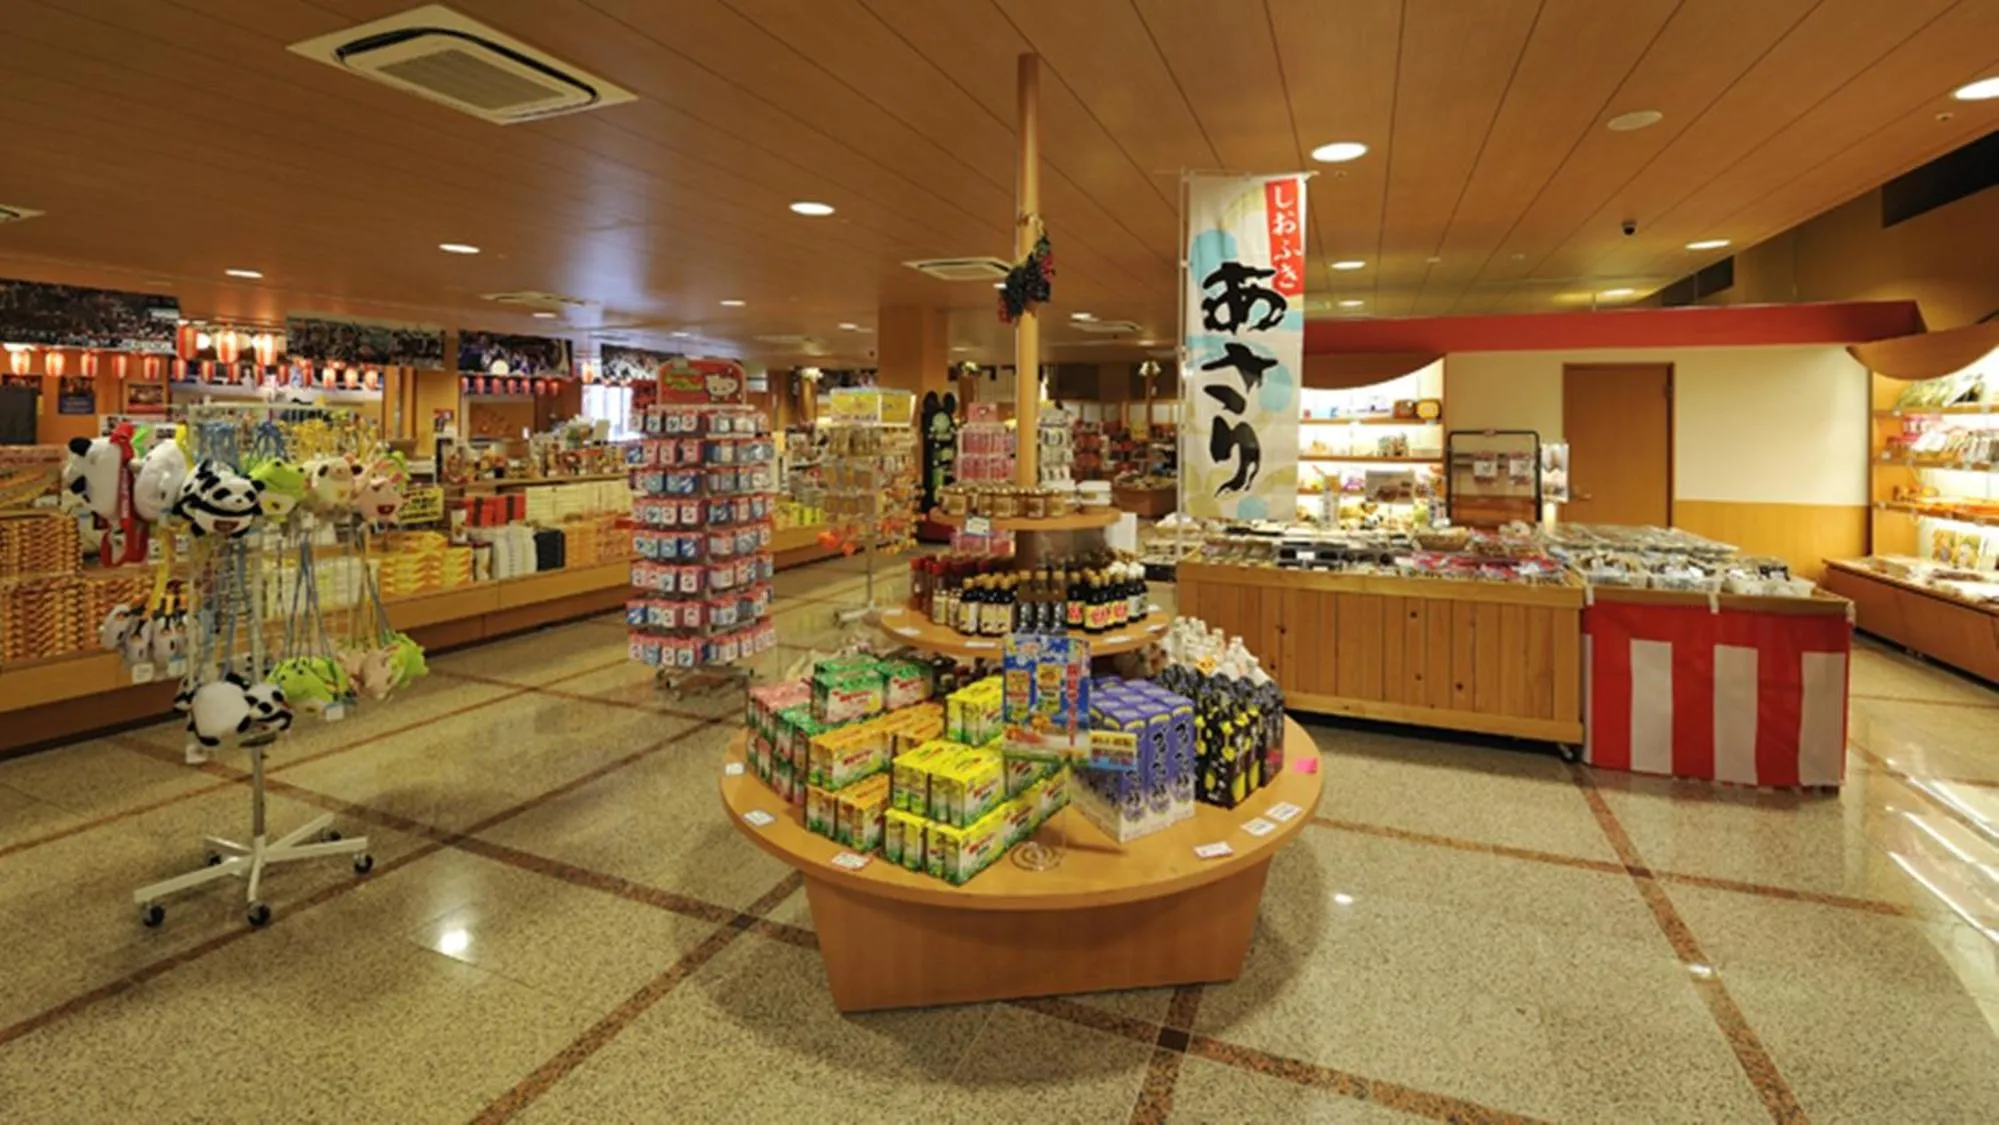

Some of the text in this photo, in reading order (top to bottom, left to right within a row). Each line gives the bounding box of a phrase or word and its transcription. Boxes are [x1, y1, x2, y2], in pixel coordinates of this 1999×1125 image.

[1272, 185, 1303, 289] しおふき
[1200, 261, 1288, 498] あさり
